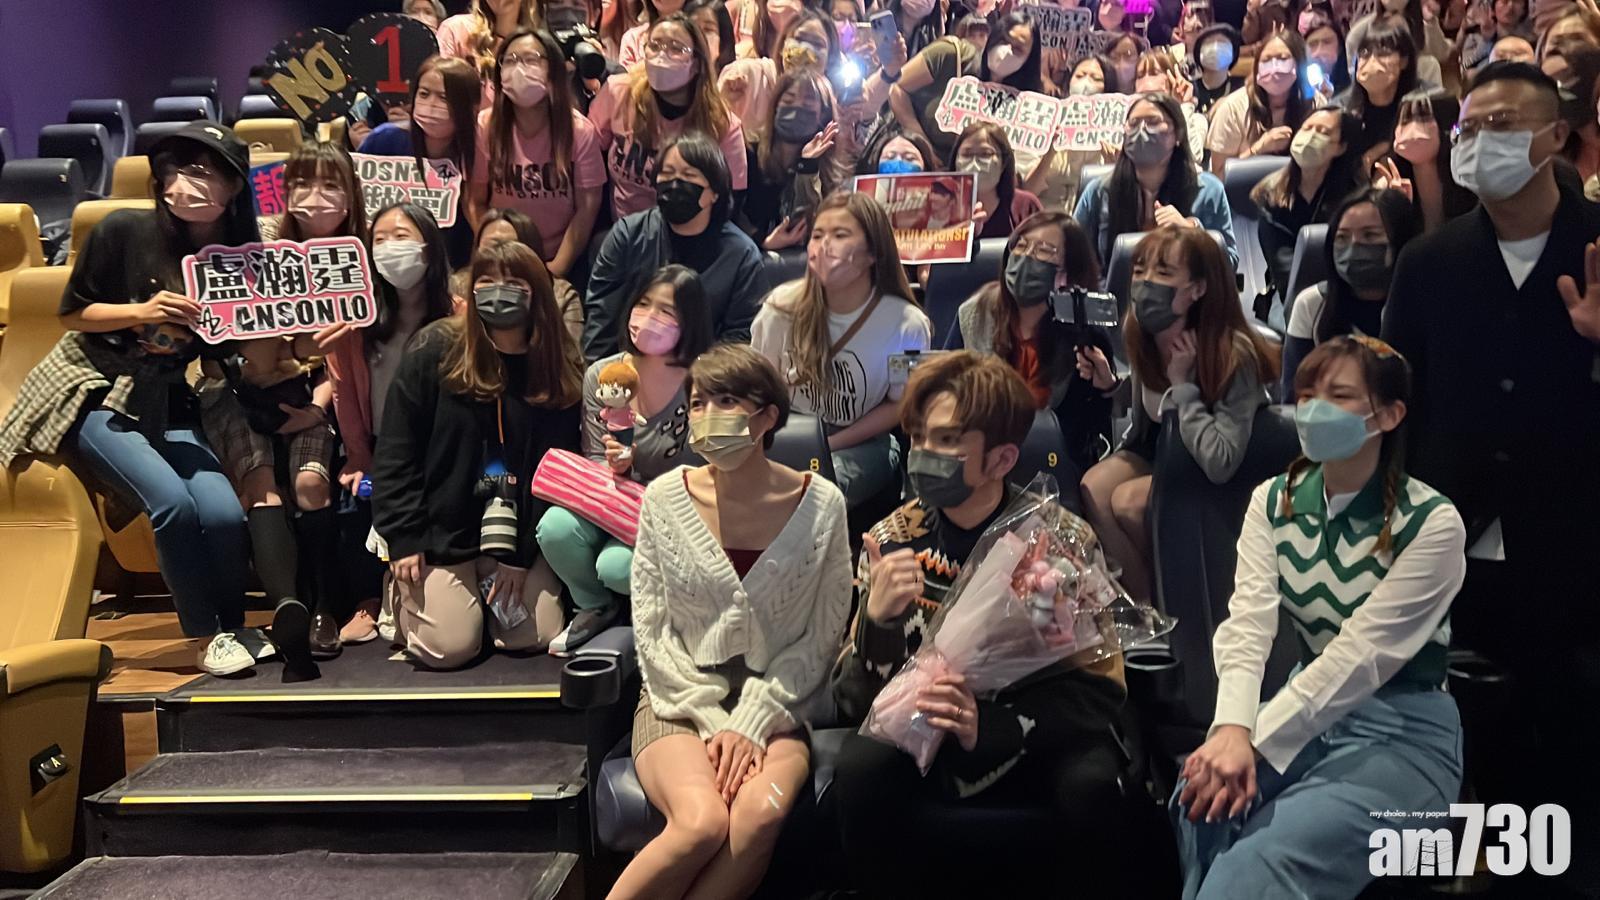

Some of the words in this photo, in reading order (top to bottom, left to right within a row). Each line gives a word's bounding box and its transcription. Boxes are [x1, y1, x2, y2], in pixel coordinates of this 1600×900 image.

[374, 25, 410, 93] 1
[268, 40, 347, 120] NO
[354, 160, 425, 184] ANSO
[894, 227, 969, 242] ATULATIONS!
[194, 245, 366, 301] 盧瀚霆
[235, 298, 338, 332] ANSON
[340, 295, 369, 322] LO
[810, 457, 820, 471] 8
[1048, 452, 1058, 467] 9
[45, 477, 55, 490] 7
